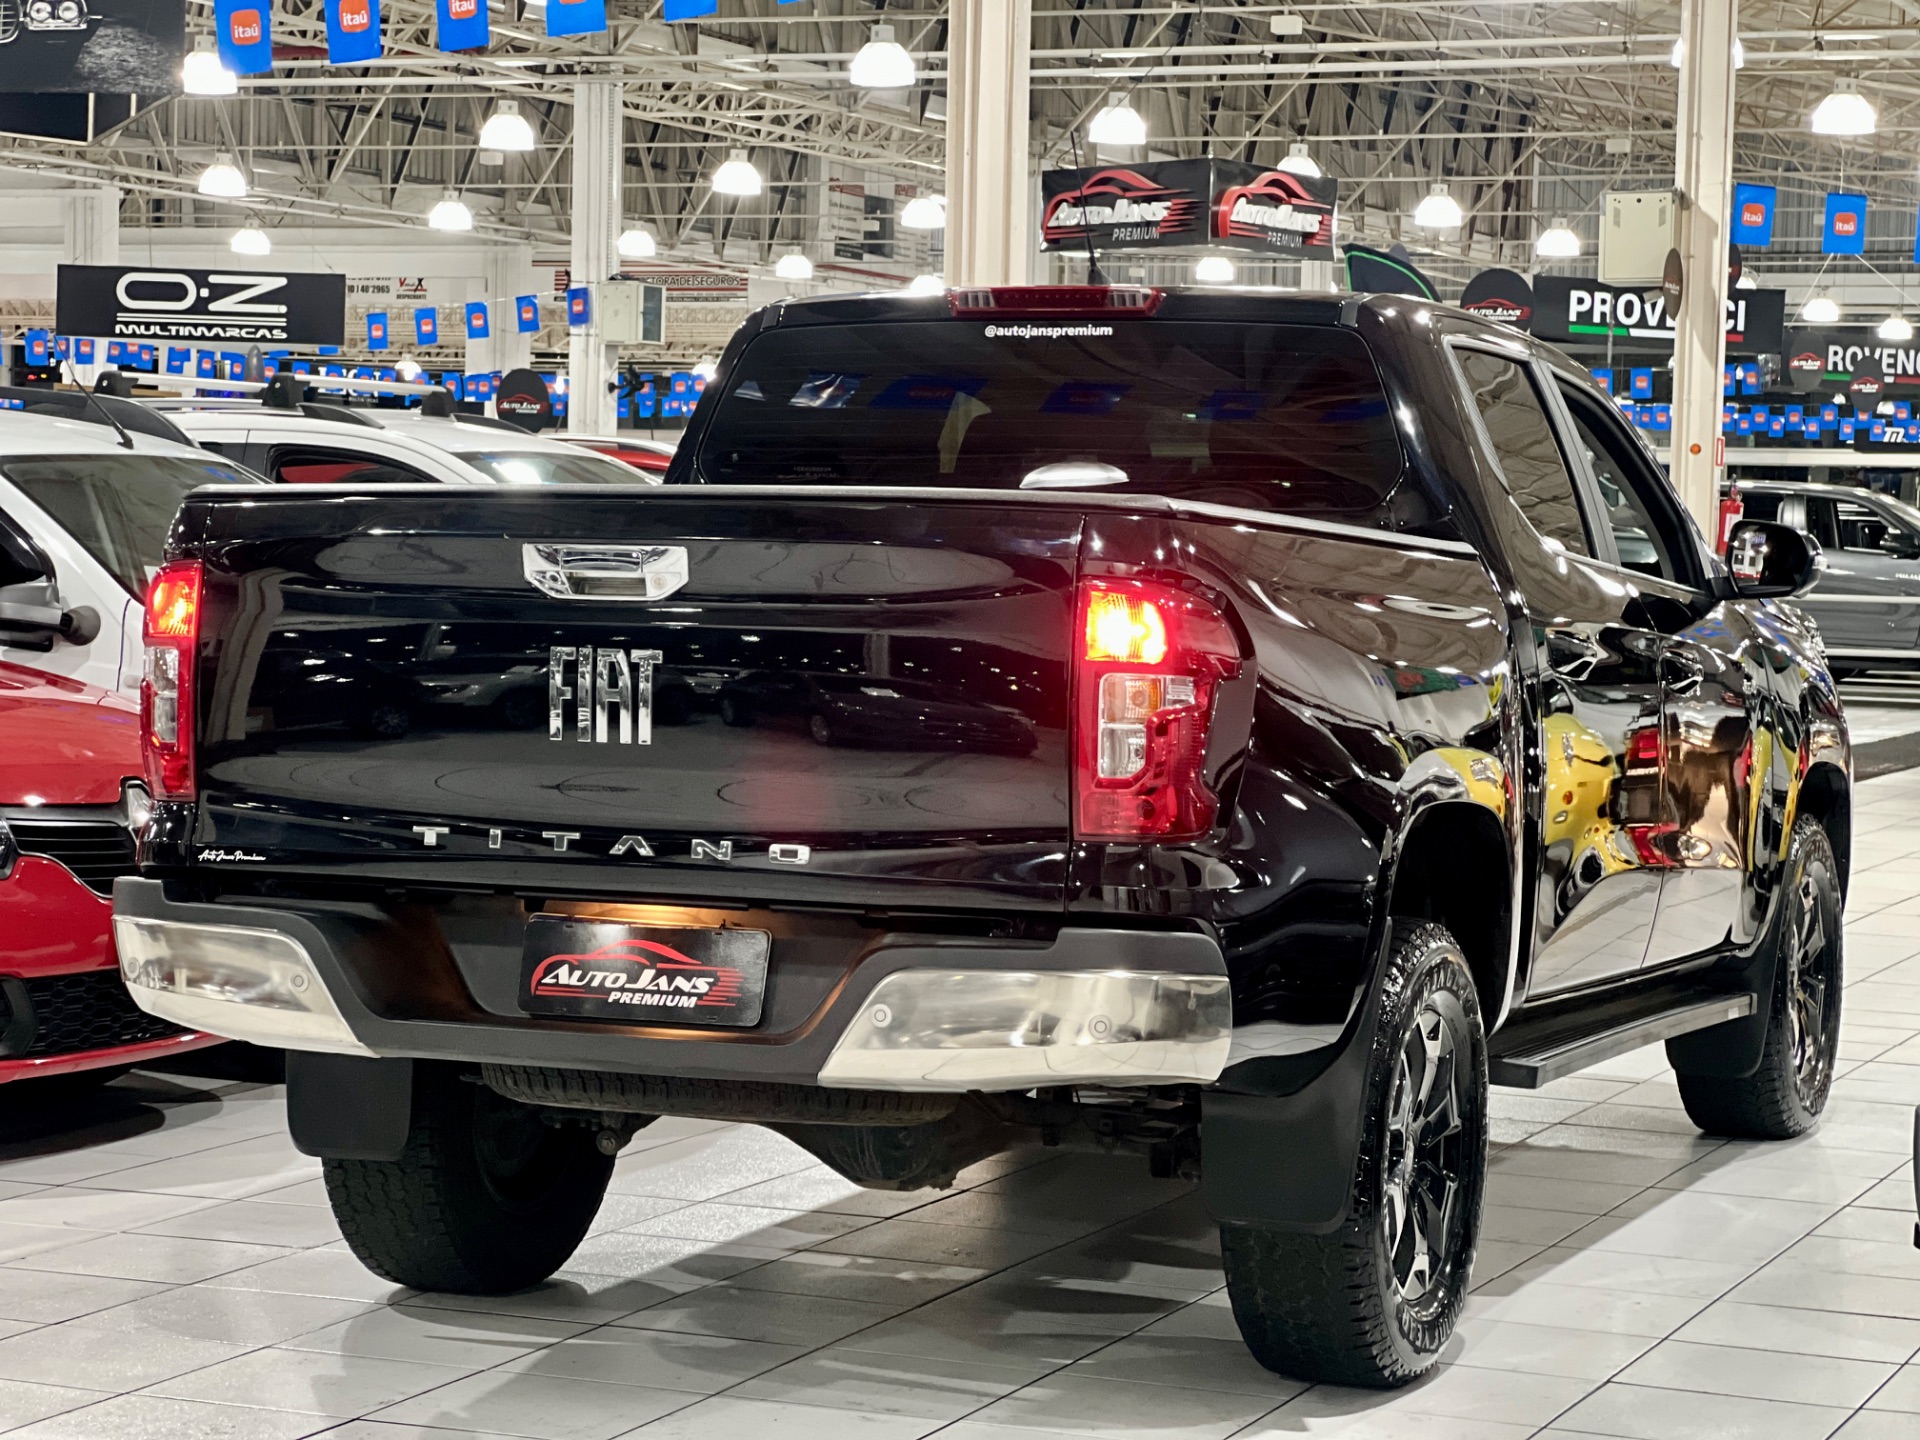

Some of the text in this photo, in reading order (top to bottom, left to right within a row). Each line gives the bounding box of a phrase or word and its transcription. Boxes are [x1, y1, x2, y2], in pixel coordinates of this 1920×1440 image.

[342, 12, 367, 27] itaú
[233, 23, 259, 39] itaú
[1743, 211, 1763, 223] itaú
[1112, 226, 1160, 241] PREMIUM
[1835, 221, 1855, 232] itaú
[1266, 231, 1303, 248] PREMIUM
[115, 324, 288, 339] MULTIMARCAS
[985, 324, 1113, 339] @autojanspremium
[549, 646, 663, 745] FIAT
[412, 825, 811, 865] TITANO
[607, 990, 698, 1009] PREMIUM
